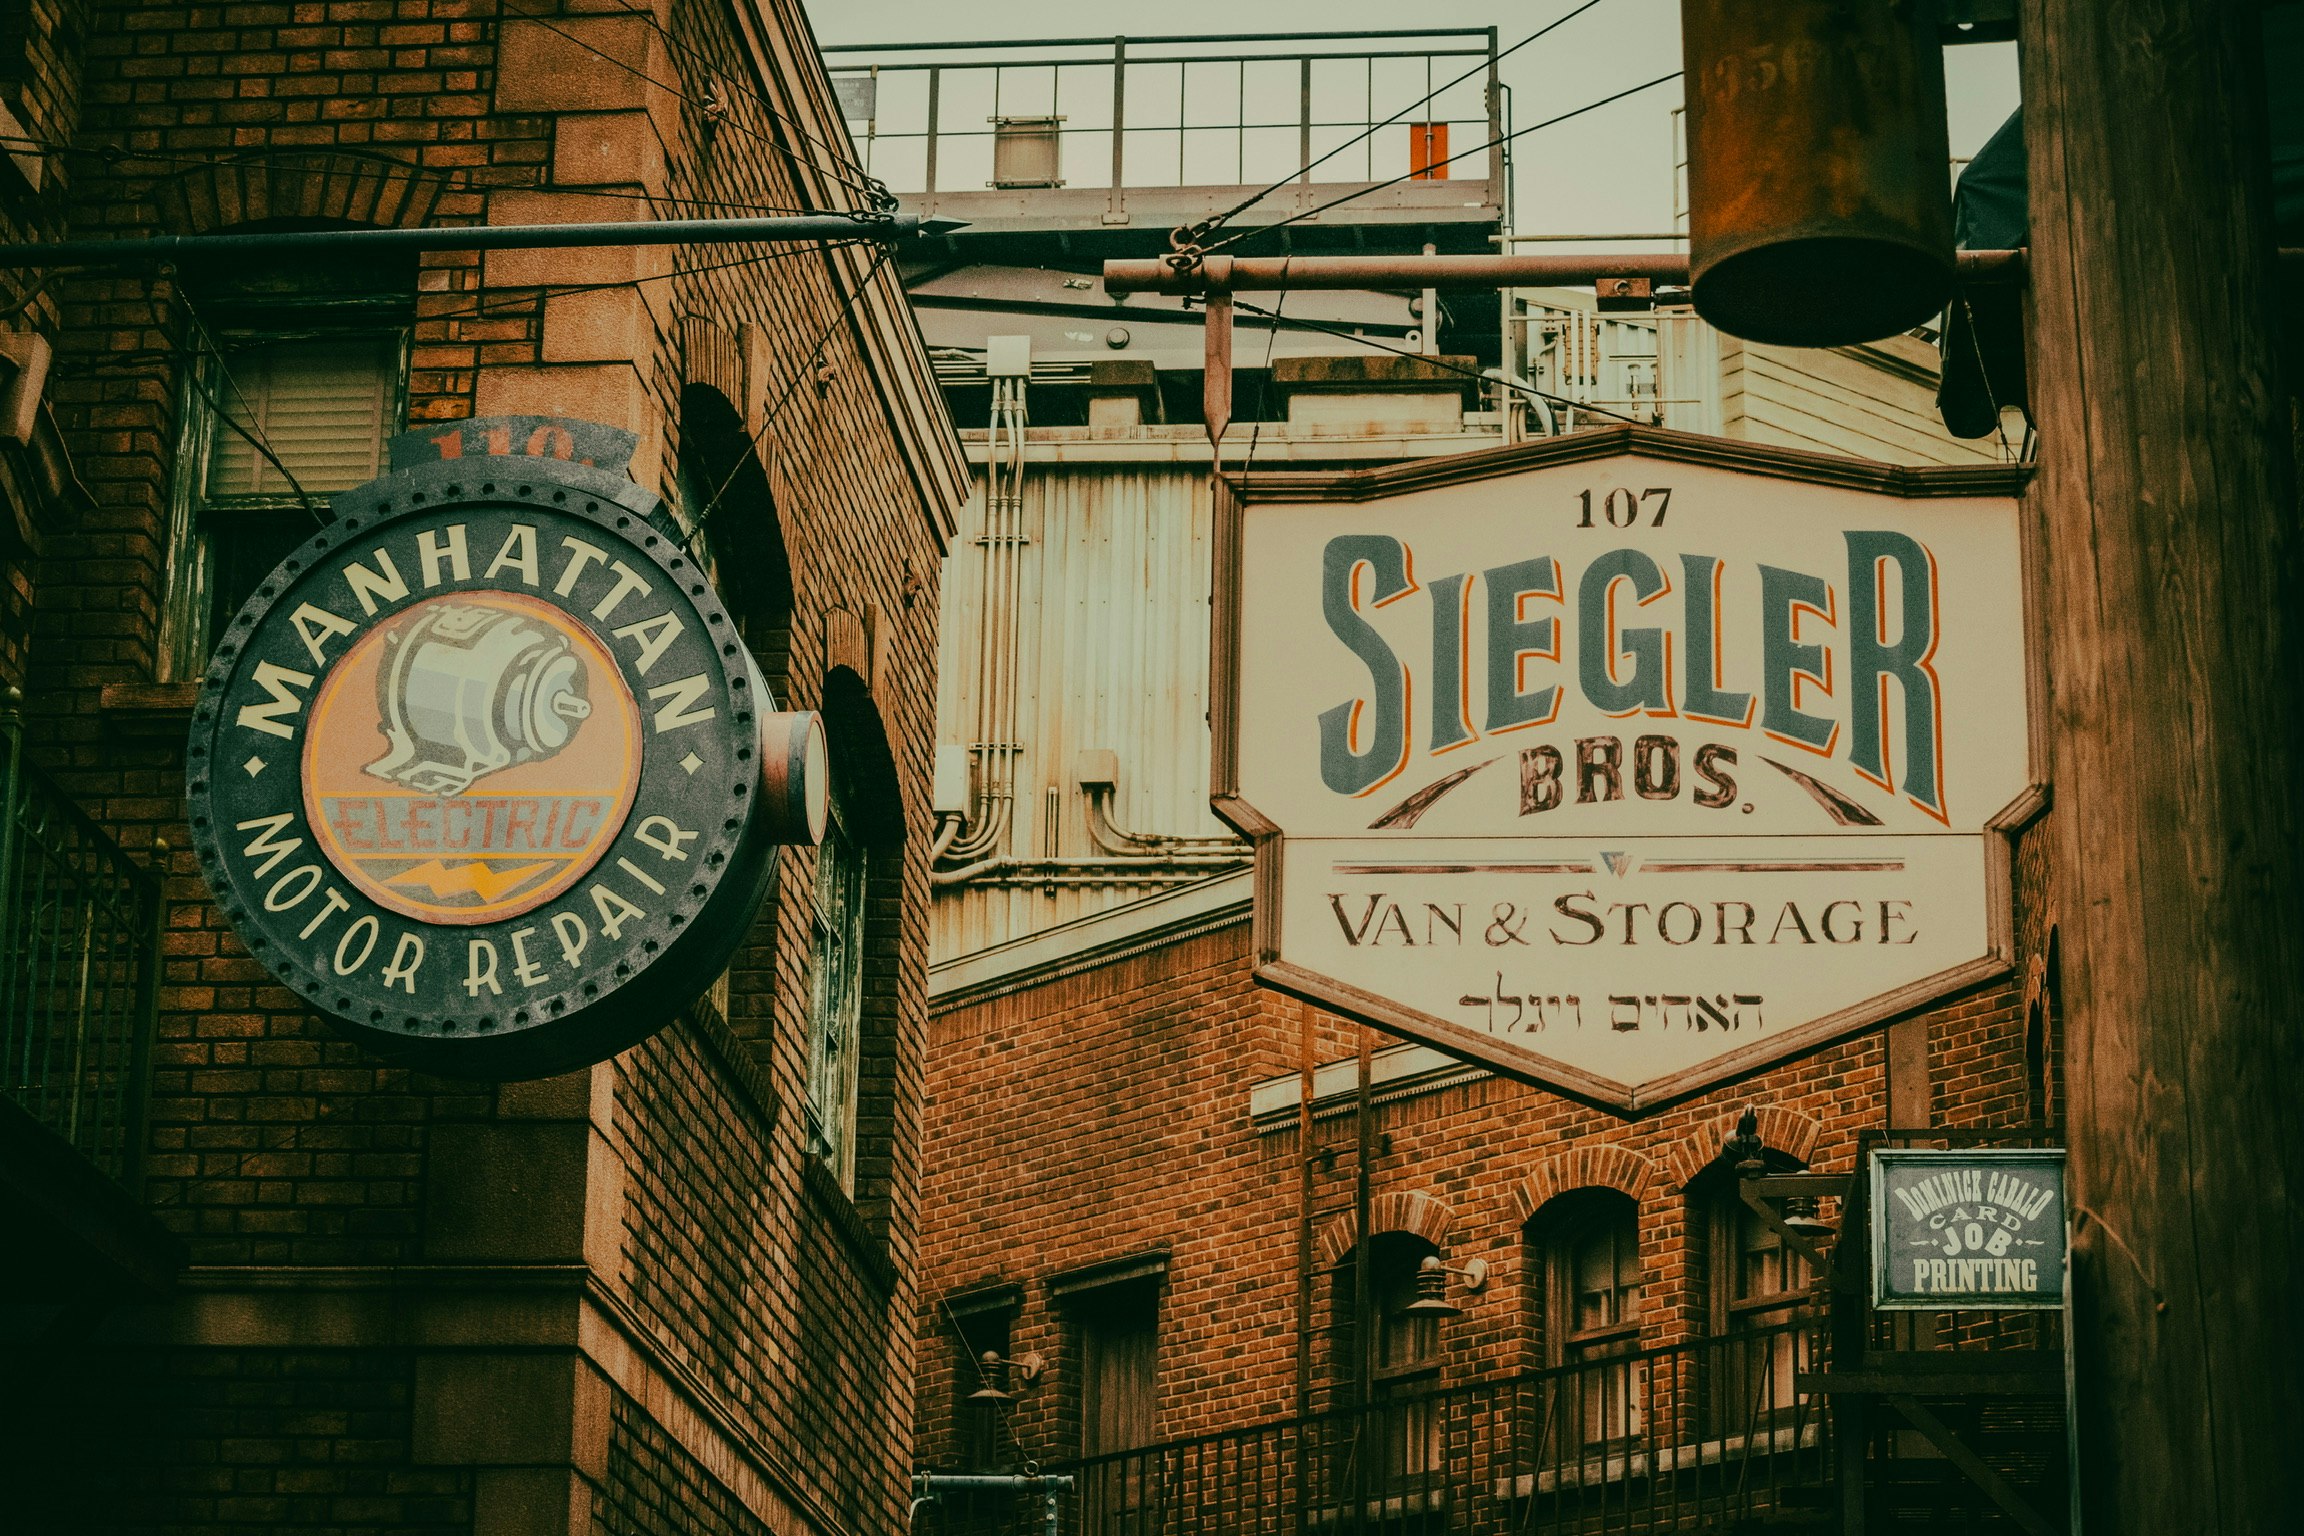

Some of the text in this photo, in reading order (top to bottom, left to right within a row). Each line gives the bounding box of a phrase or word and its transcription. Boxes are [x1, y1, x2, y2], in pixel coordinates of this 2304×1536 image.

[1575, 487, 1673, 529] 107
[236, 523, 716, 740] MANHATTAN
[1317, 530, 1951, 828] SIEGLER
[1518, 734, 1755, 818] BROS.
[331, 799, 600, 849] ELECTRIC
[236, 812, 700, 997] MOTOR REPAIR
[1484, 902, 1528, 947] &
[1894, 1170, 1982, 1222] DOMINICK
[1929, 1205, 2021, 1231] CARD
[1943, 1222, 2013, 1257] JOB
[1913, 1258, 2038, 1293] PRINTING
